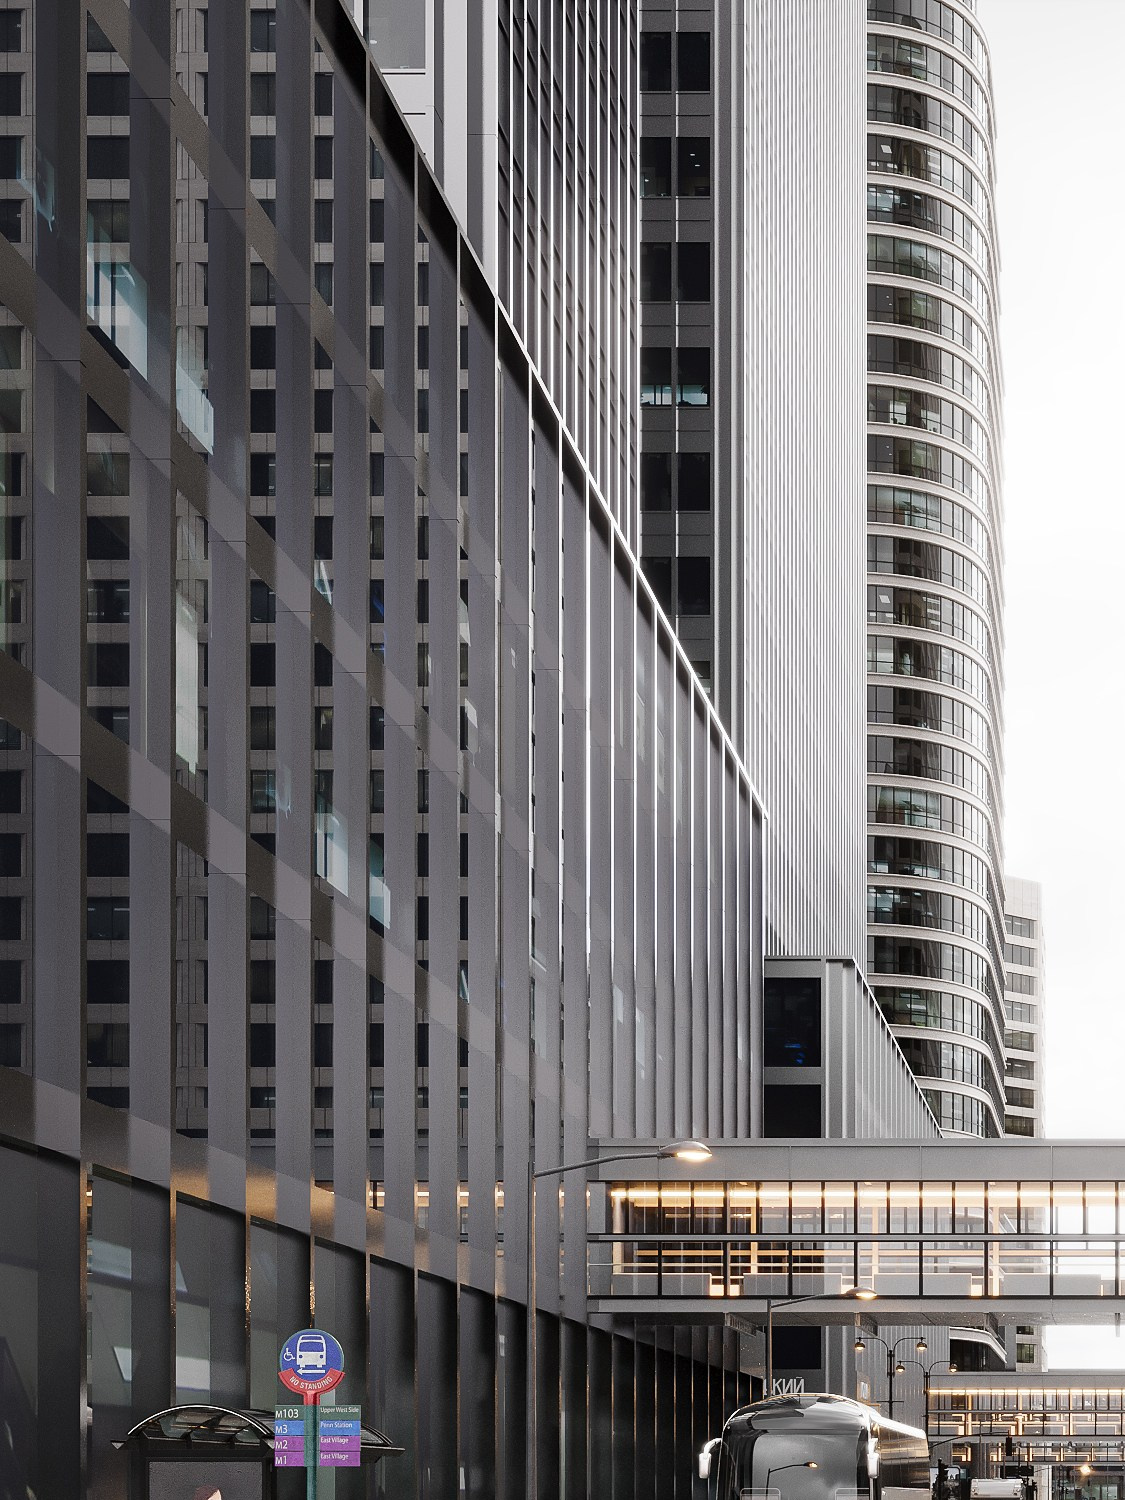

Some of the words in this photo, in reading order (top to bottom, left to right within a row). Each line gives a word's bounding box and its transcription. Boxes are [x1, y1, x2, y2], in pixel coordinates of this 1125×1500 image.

[289, 1376, 299, 1386] NO
[300, 1376, 333, 1390] STANDING
[764, 1376, 805, 1396] КИЙ
[275, 1409, 299, 1418] M103
[275, 1425, 288, 1433] M3
[275, 1441, 288, 1449] M2
[275, 1456, 287, 1464] M1
[331, 1453, 349, 1461] Village
